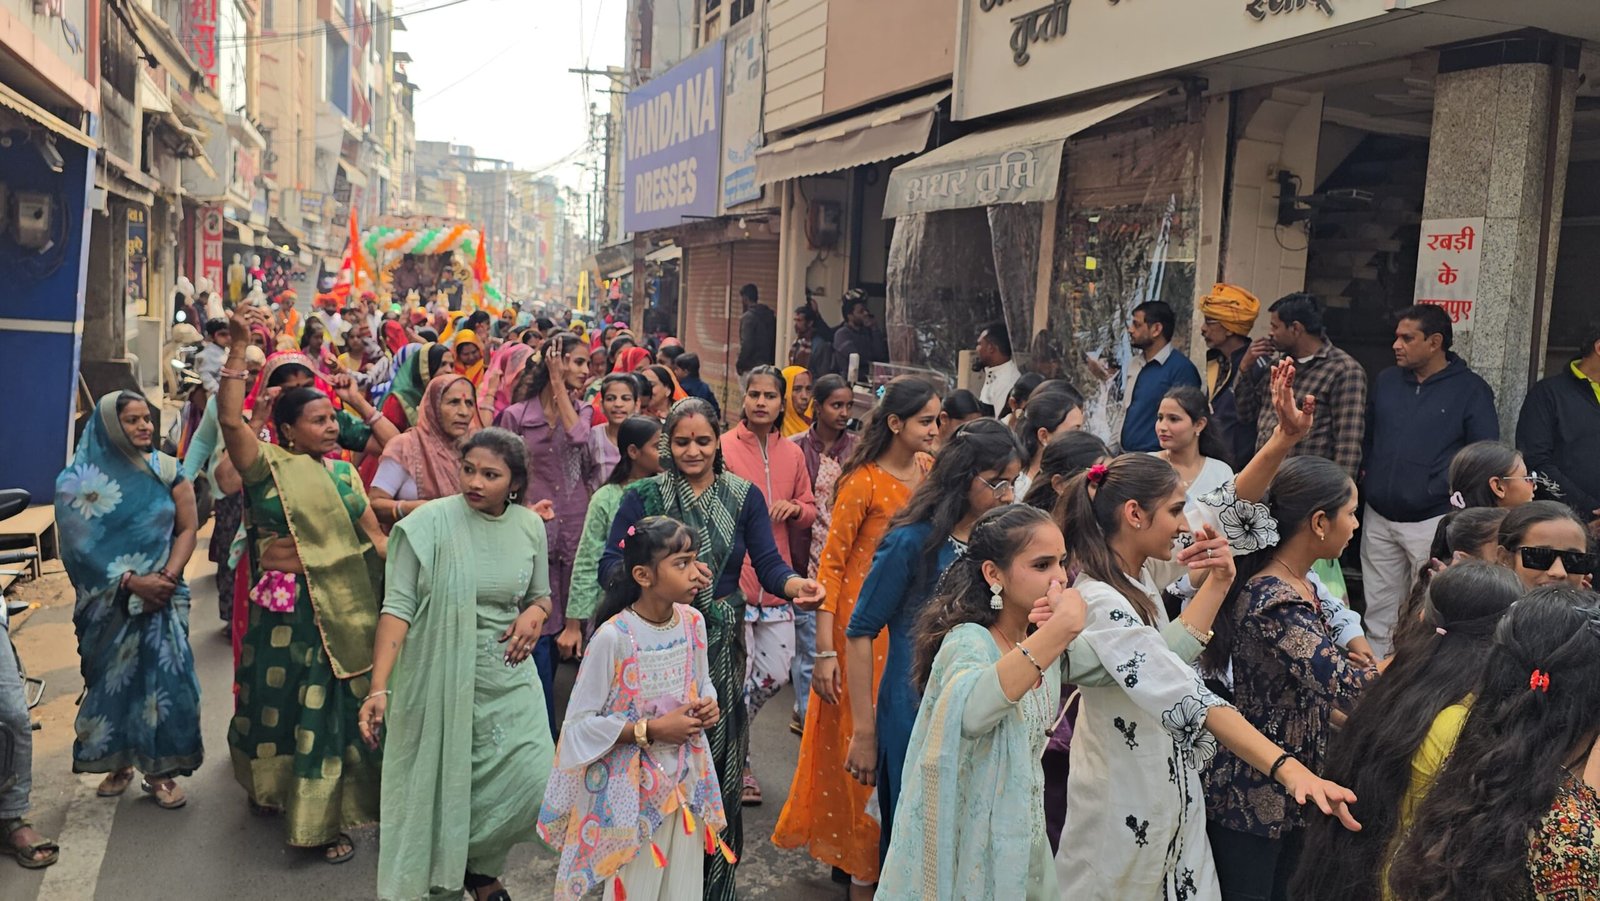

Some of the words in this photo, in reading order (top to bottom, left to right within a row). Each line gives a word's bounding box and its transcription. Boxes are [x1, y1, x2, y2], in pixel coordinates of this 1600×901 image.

[627, 66, 716, 161] VANDANA
[635, 156, 697, 214] DRESSES
[905, 168, 969, 202] अधर
[1427, 226, 1475, 254] रबड़ी
[1438, 262, 1458, 285] के
